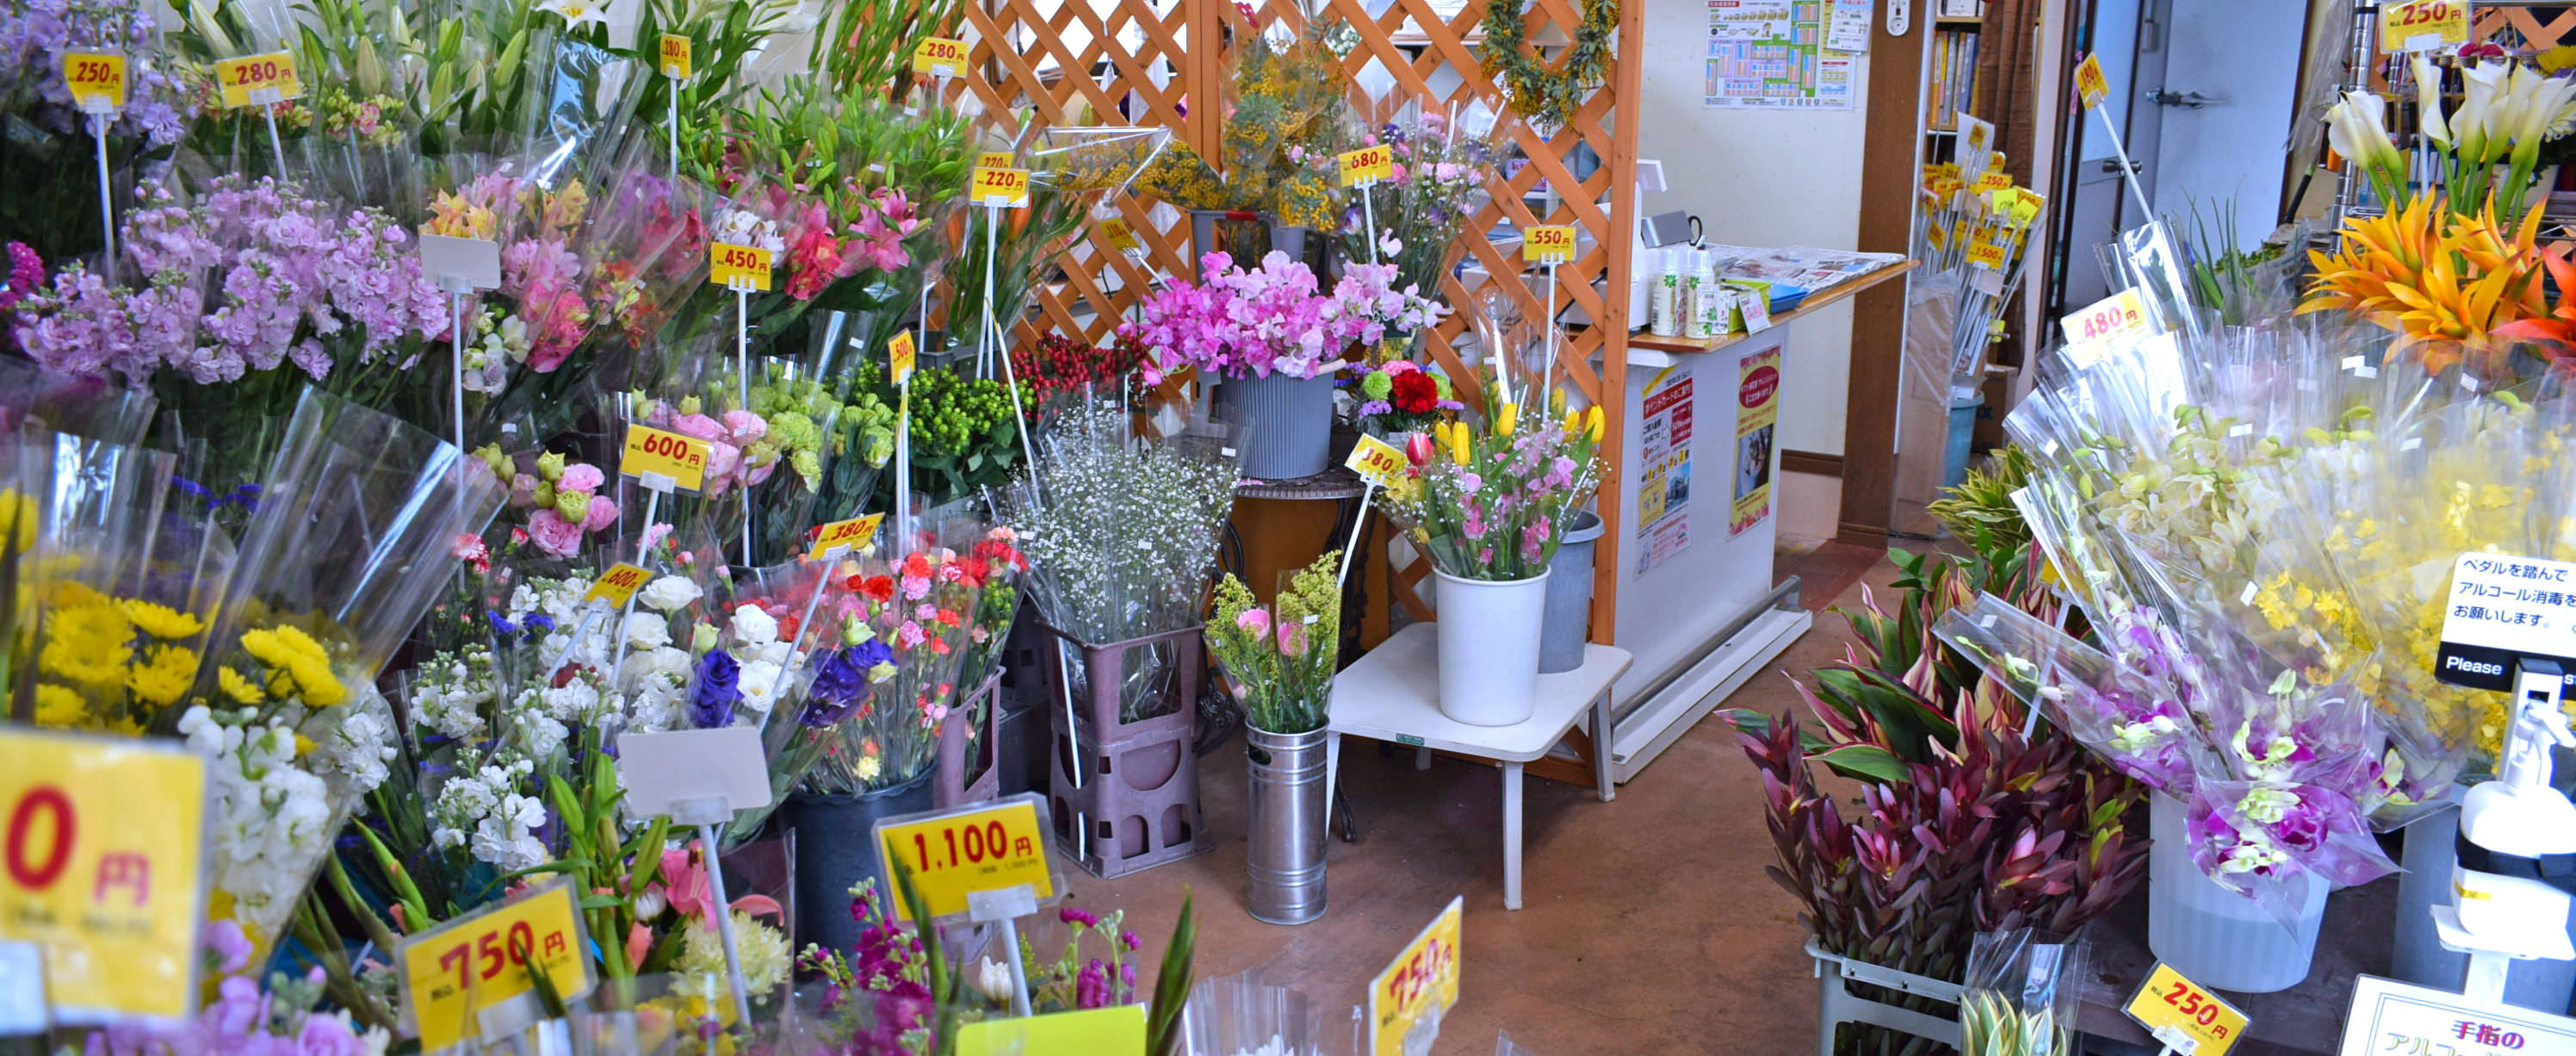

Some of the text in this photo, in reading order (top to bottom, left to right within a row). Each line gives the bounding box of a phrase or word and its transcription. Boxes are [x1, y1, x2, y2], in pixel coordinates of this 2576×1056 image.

[643, 432, 700, 466] 600円
[2463, 559, 2569, 582] ペダルを踏んで
[2459, 581, 2576, 608] アルコール消毒を
[2454, 605, 2550, 629] お願いします。
[2446, 655, 2504, 675] Please
[913, 820, 1033, 873] 1,100円
[440, 920, 567, 991] 750円
[2164, 981, 2228, 1040] 250円
[2451, 1020, 2525, 1049] 手指の
